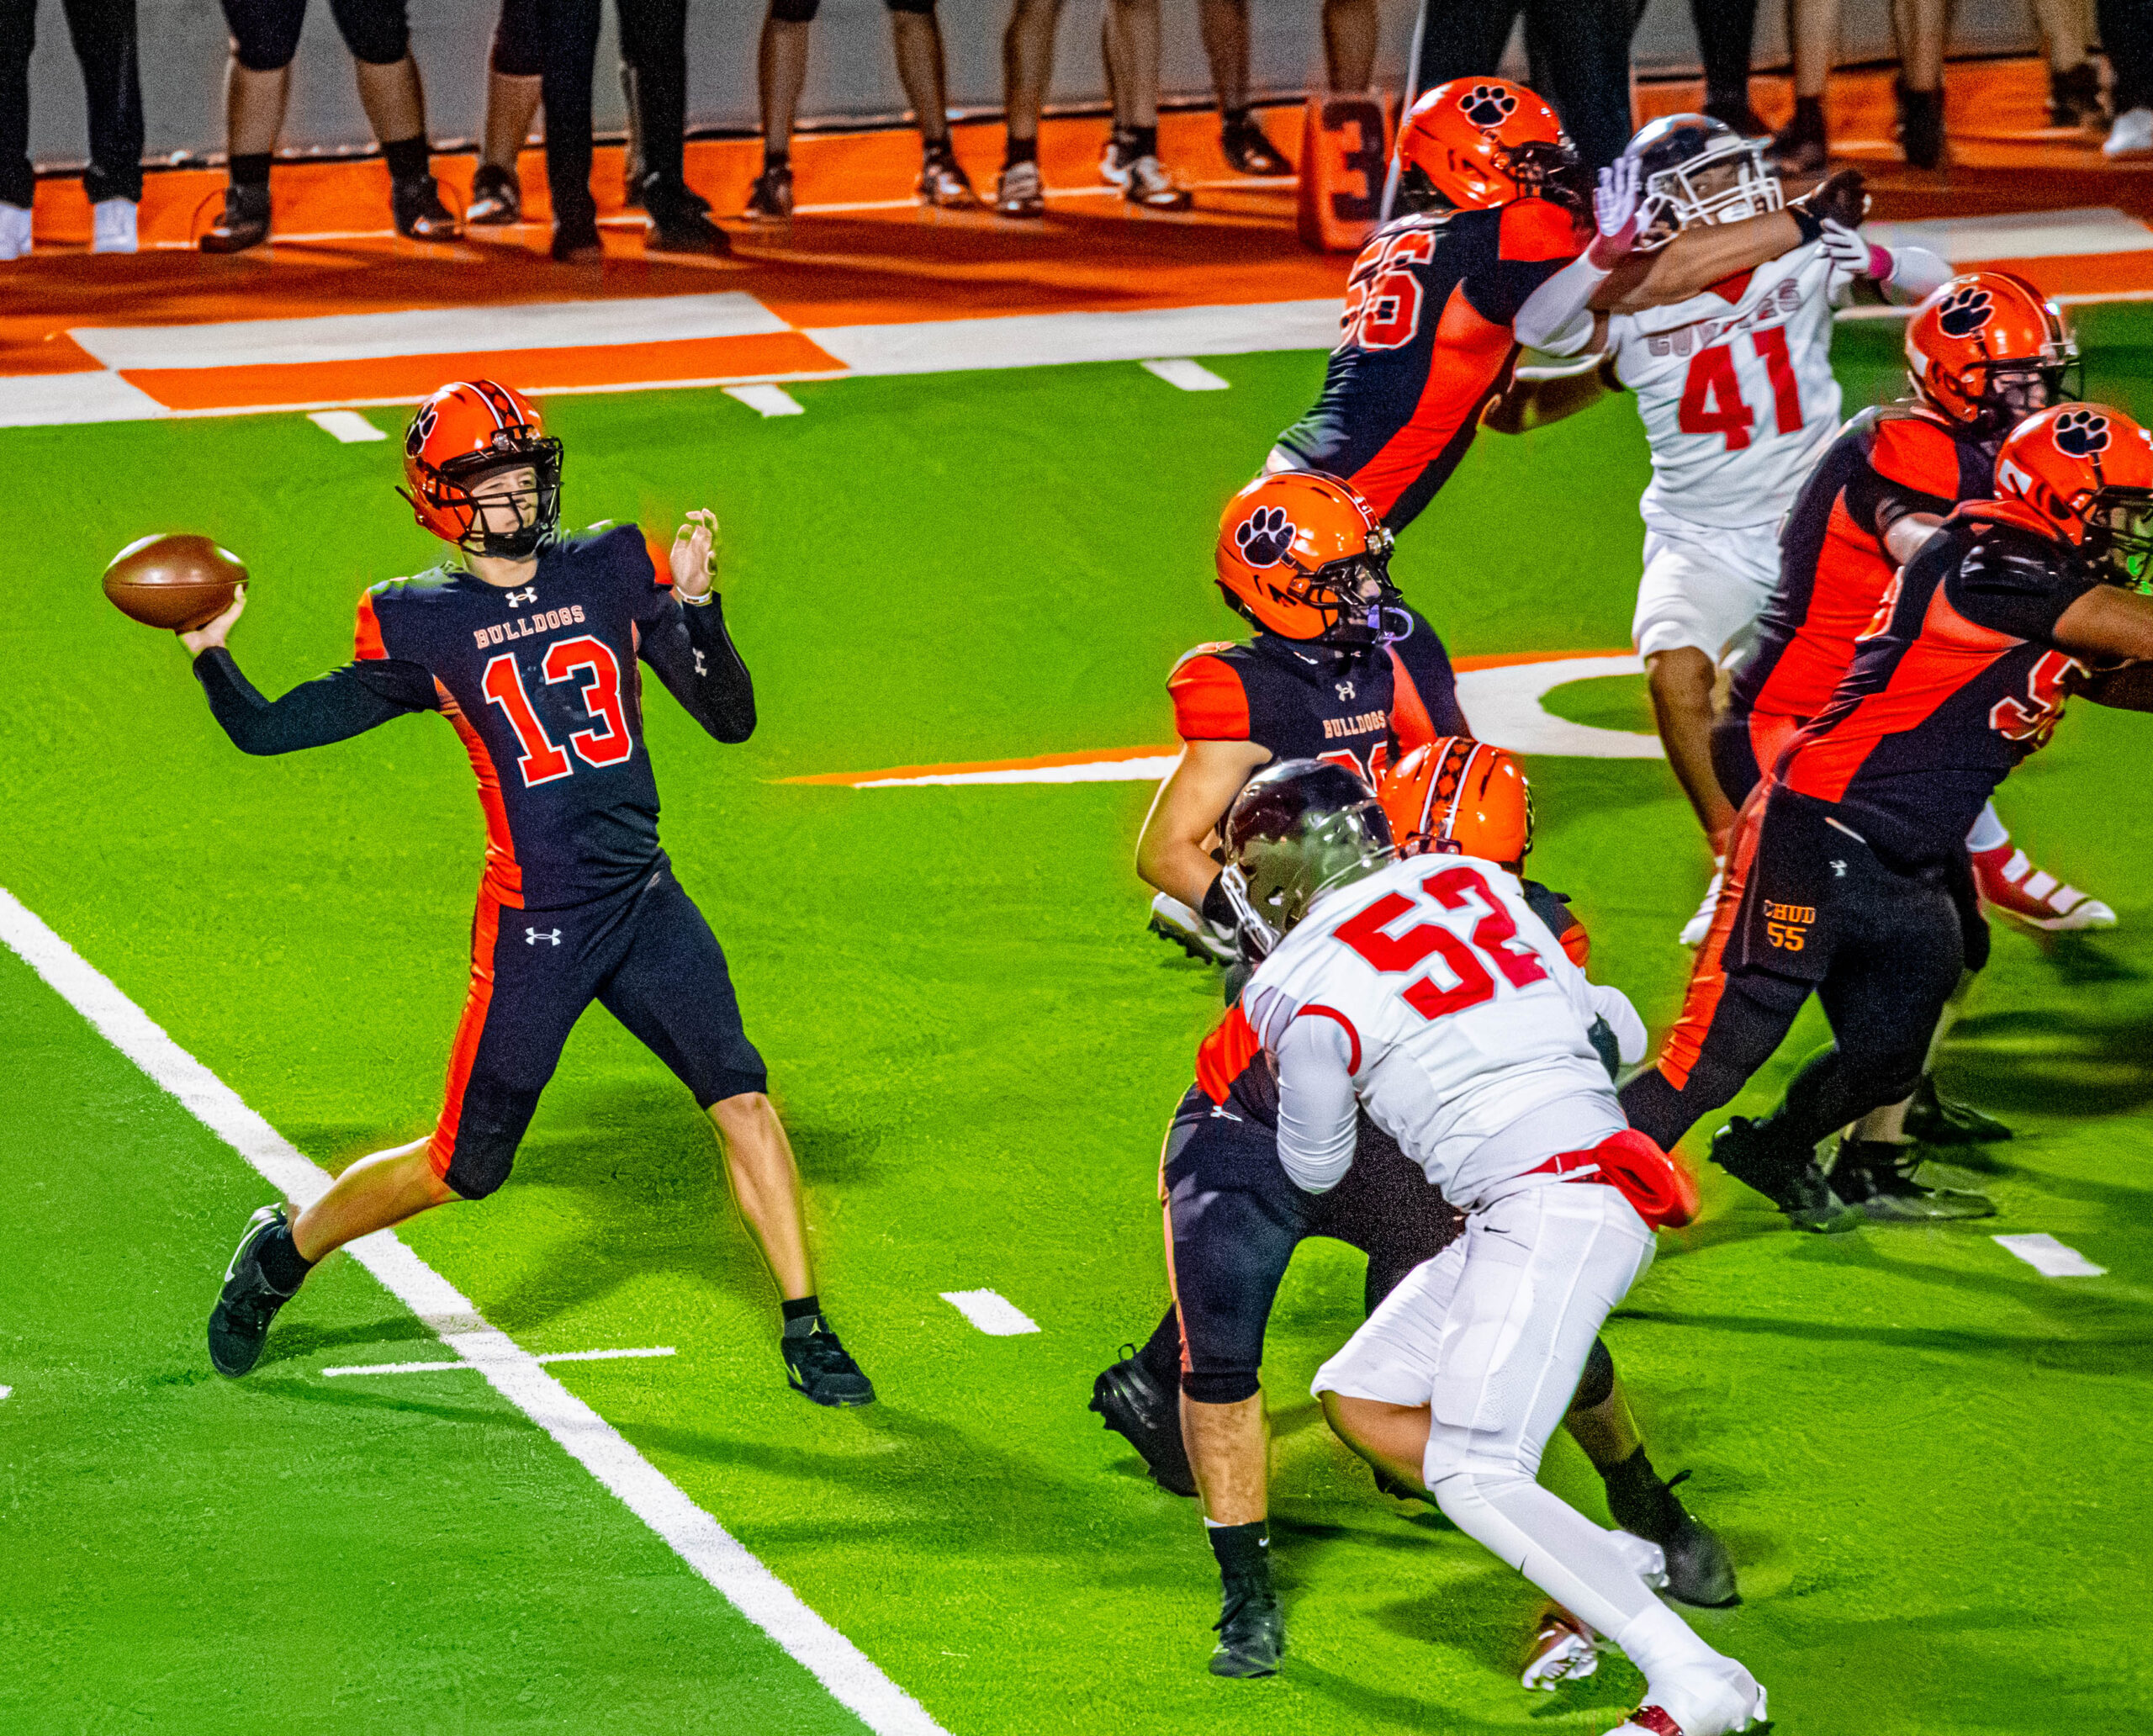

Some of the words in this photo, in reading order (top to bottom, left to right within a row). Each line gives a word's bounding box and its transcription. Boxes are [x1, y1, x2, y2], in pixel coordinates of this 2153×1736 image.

[1679, 325, 1805, 453] 41
[473, 605, 586, 649] BULLDOGS
[480, 634, 633, 788] 13
[1322, 710, 1388, 738] BULLDOGS
[1328, 865, 1549, 1023] 52
[1767, 921, 1807, 951] 55
